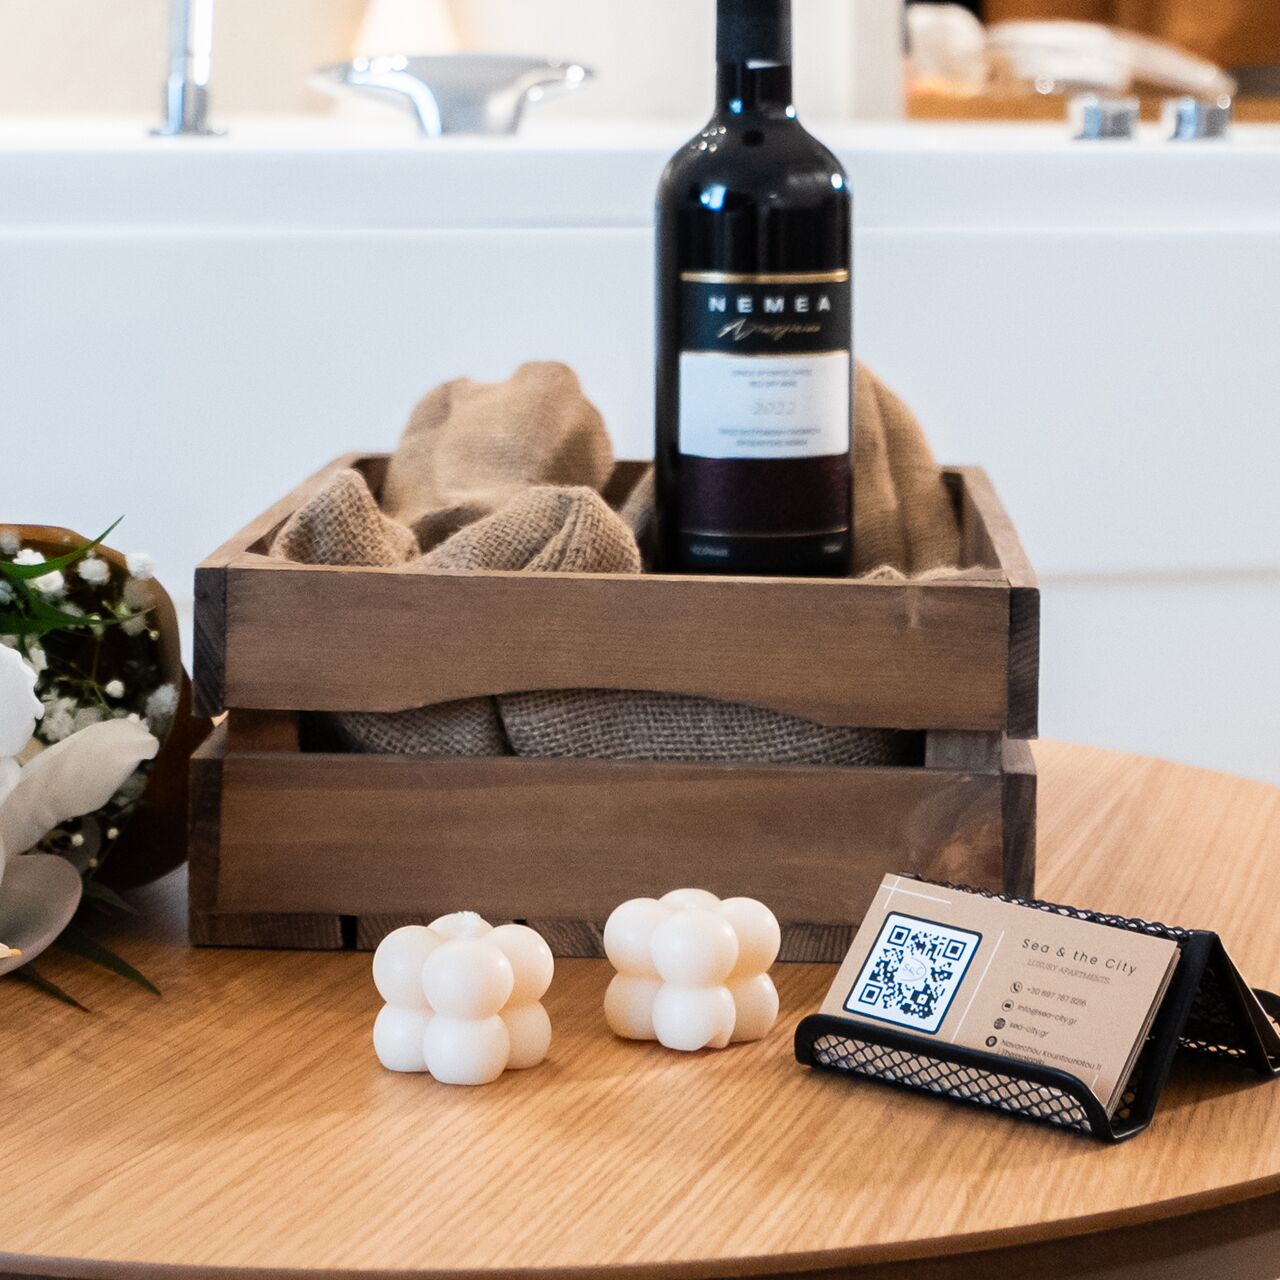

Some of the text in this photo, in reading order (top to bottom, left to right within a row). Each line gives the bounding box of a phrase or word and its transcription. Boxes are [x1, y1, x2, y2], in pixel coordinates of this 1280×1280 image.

[708, 295, 831, 313] NEMEA
[1022, 938, 1137, 976] Sea & the City
[1027, 959, 1111, 985] LUXURY APARTMENTS
